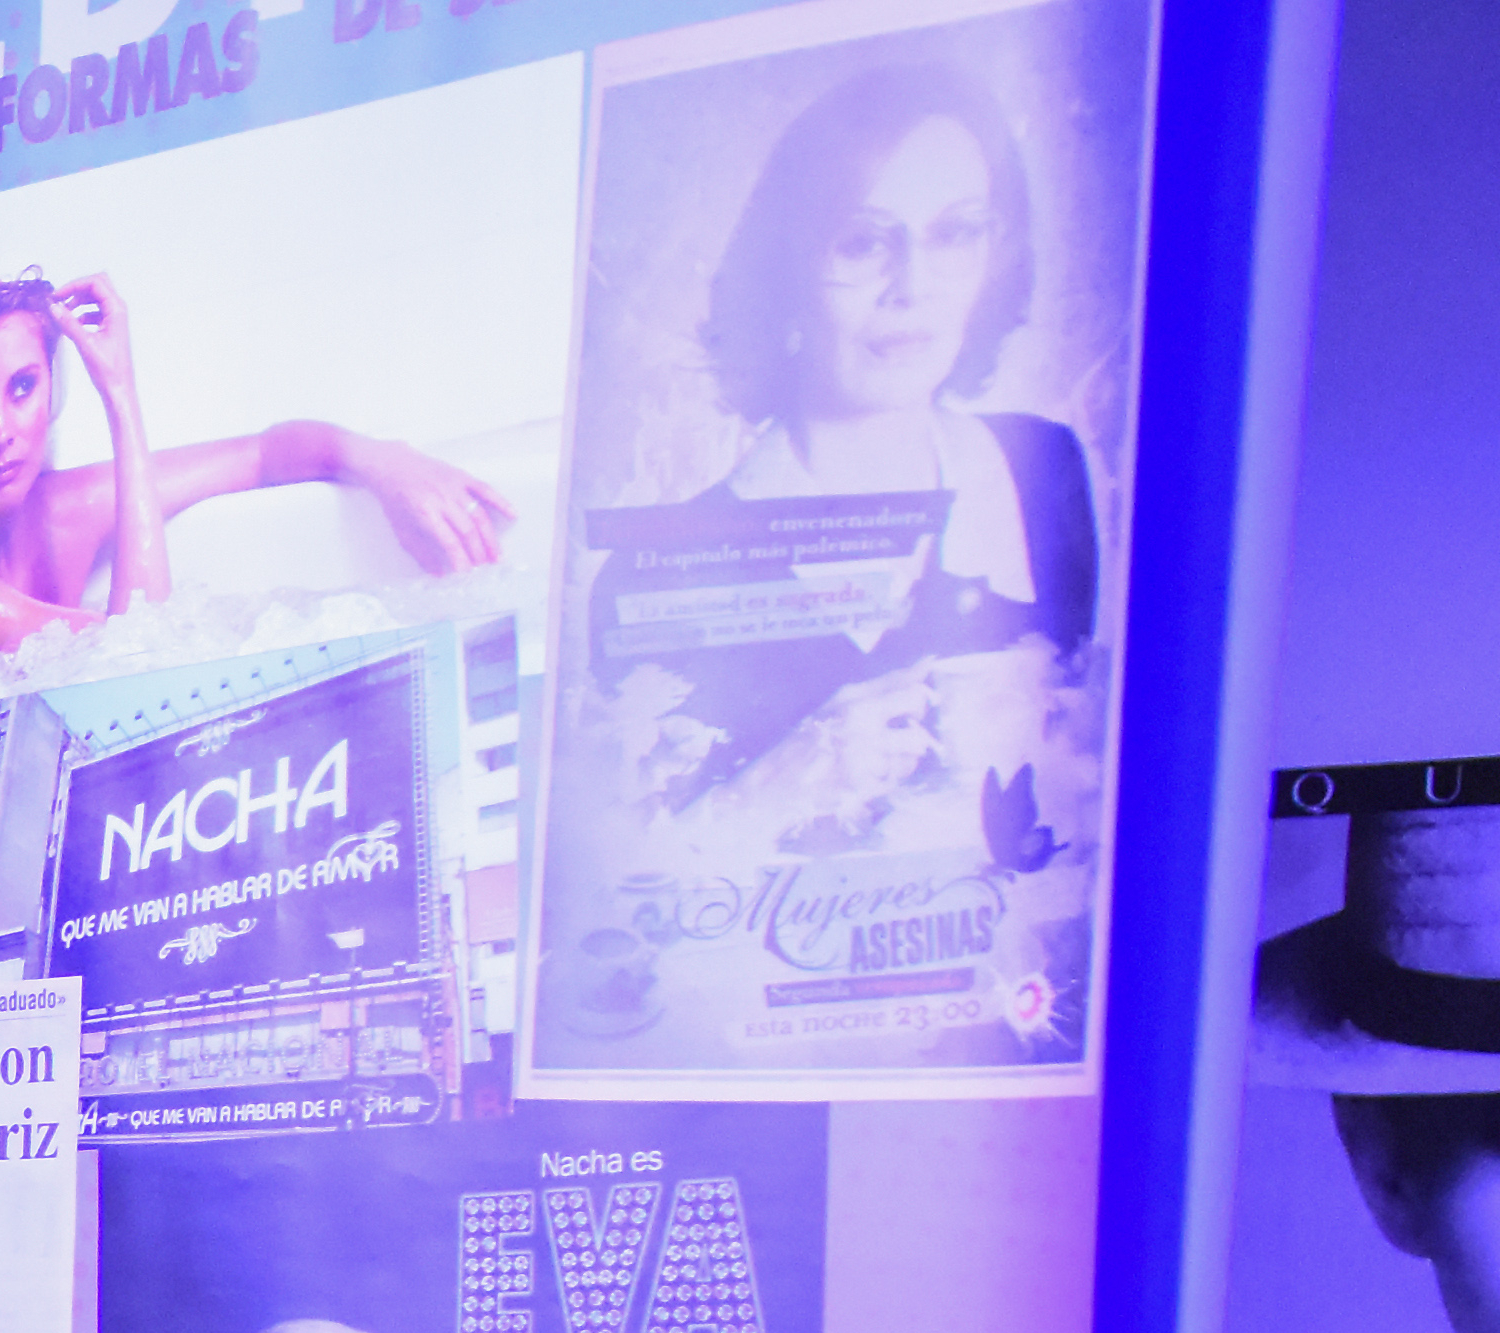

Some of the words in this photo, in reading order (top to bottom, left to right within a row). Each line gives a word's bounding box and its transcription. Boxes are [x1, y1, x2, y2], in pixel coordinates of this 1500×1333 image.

[100, 738, 349, 881] NACHA
[60, 910, 95, 948] QUE
[97, 904, 128, 935] ME
[133, 896, 173, 927] VAN
[173, 892, 187, 917] A
[192, 872, 272, 915] HABLAR
[277, 863, 307, 892] DE
[850, 904, 994, 974] ASESINAS
[541, 1149, 623, 1178] Nacha
[630, 1149, 664, 1172] es
